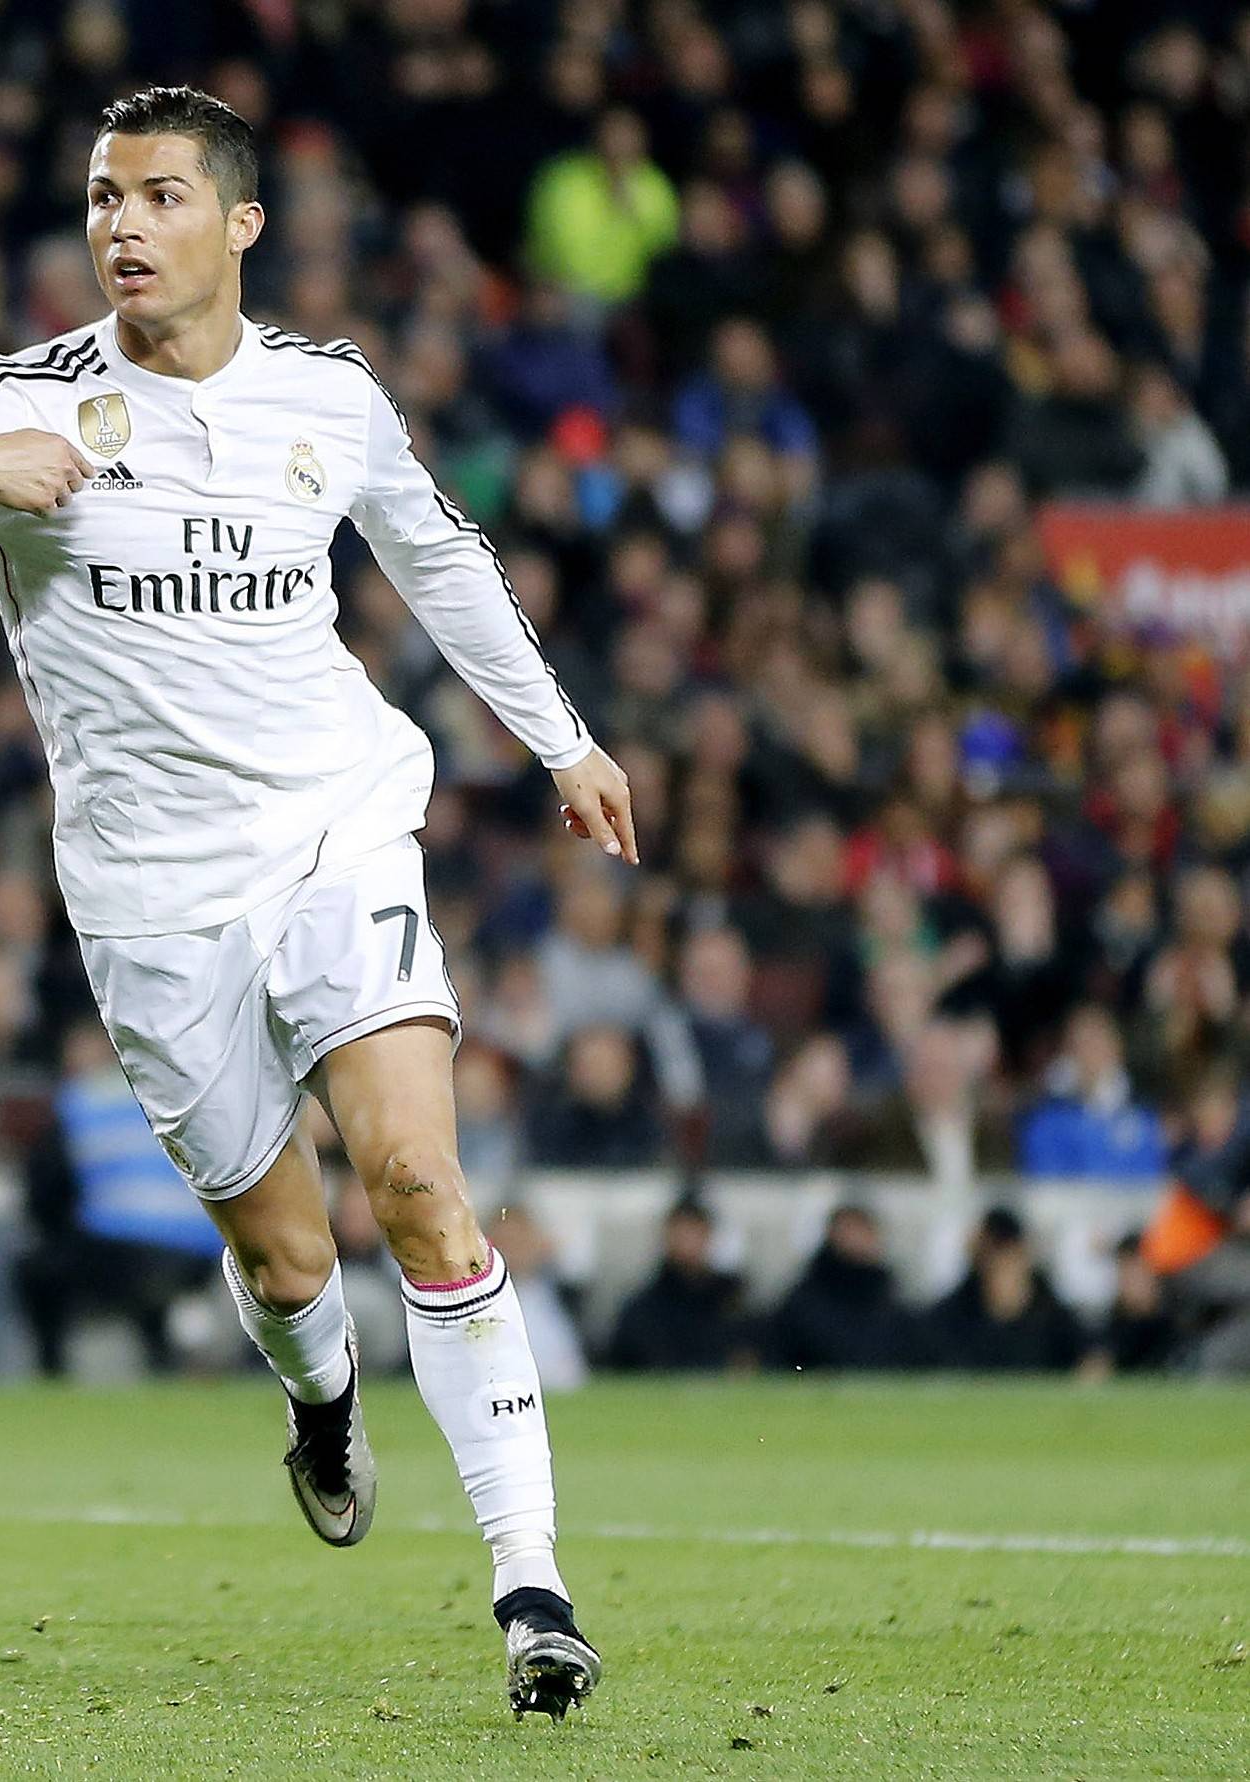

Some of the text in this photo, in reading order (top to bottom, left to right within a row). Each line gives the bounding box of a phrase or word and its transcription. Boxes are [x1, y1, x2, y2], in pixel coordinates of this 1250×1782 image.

[94, 432, 121, 445] FIFA
[91, 477, 143, 491] adidas
[182, 517, 253, 561] Fly
[87, 560, 315, 613] Emirates
[370, 905, 419, 982] 7
[491, 1393, 536, 1416] RM
